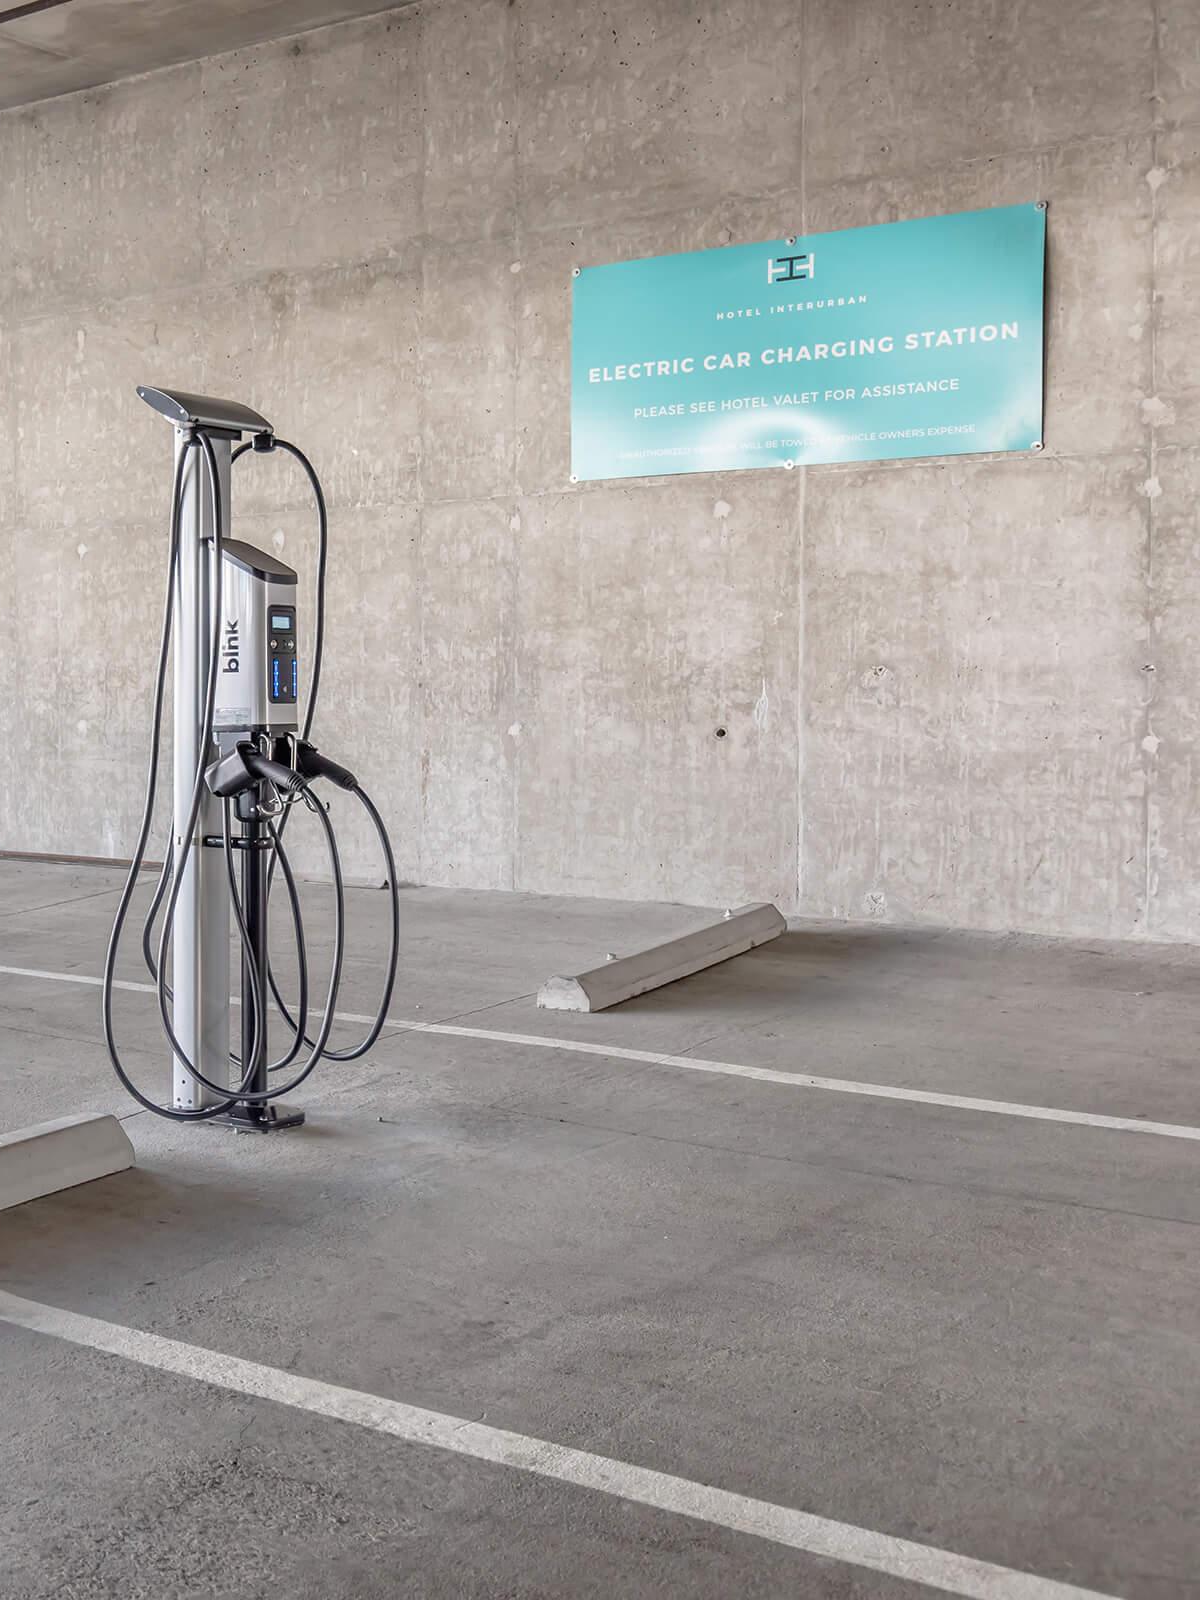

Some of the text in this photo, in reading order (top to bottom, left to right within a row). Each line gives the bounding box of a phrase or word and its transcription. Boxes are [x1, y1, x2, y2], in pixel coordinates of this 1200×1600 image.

[716, 295, 867, 320] HOTEL INTERURBAN
[588, 321, 1019, 383] ELECTRIC CAR CHARGING STATION
[634, 378, 960, 419] PLEASE SEE HOTEL VALET FOR ASSISTANCE
[766, 439, 778, 449] BE
[879, 428, 925, 440] OWNERS
[927, 424, 976, 436] EXPENSE
[222, 619, 240, 673] blink
